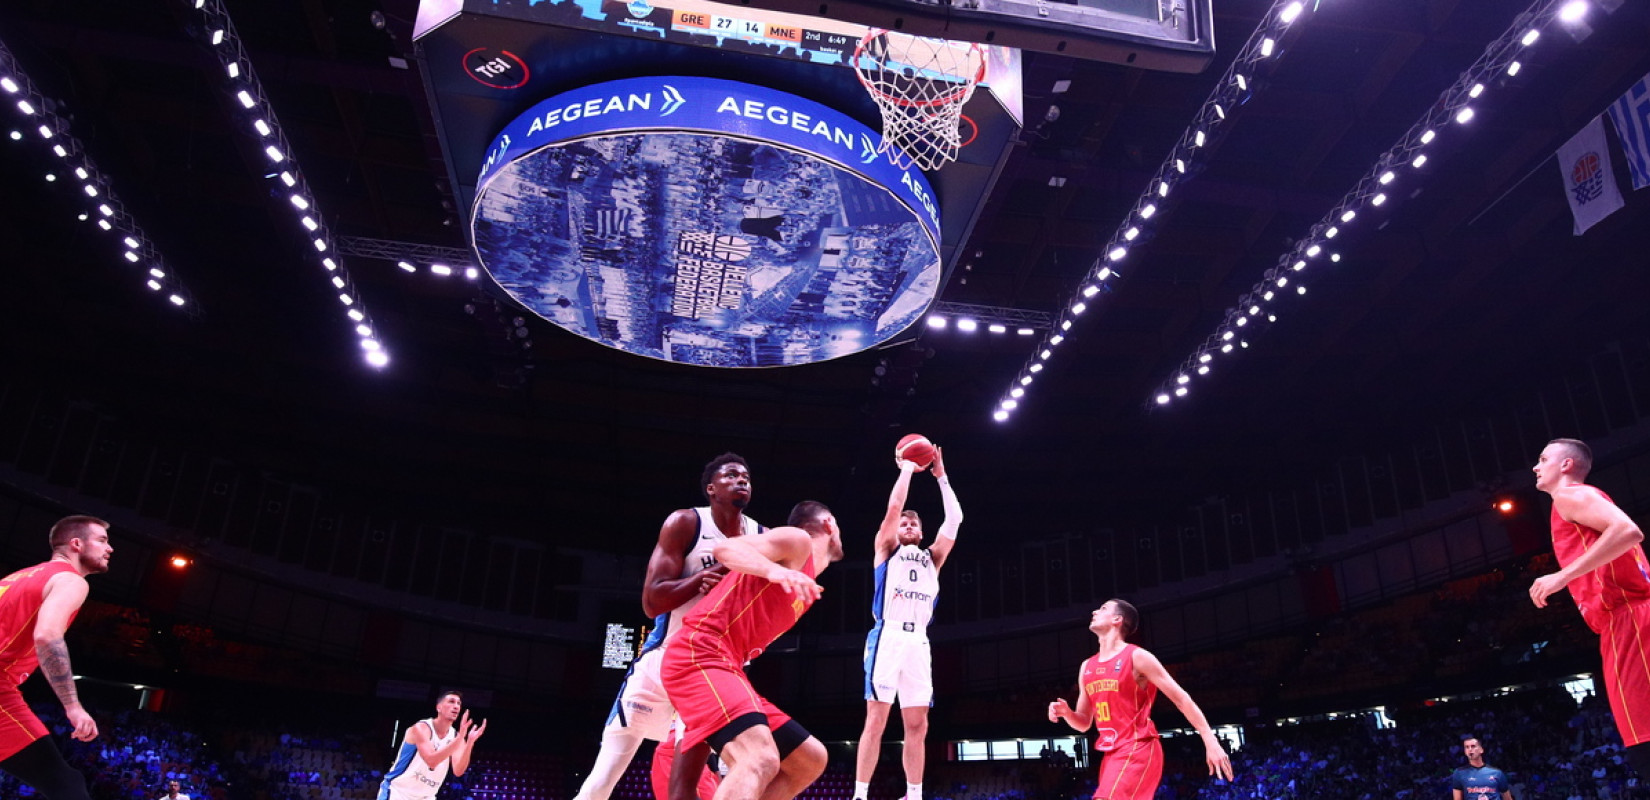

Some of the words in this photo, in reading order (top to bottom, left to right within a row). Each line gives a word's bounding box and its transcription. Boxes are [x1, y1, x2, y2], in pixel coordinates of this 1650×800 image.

[681, 13, 704, 26] GRE
[717, 17, 732, 29] 27
[745, 21, 759, 33] 14
[769, 26, 796, 39] MNE
[805, 31, 820, 41] 2nd
[828, 35, 847, 45] 6:49
[475, 57, 511, 78] TGI
[526, 92, 651, 137] AEGEAN
[717, 96, 854, 151] AEGEAN
[672, 256, 701, 317] FEDERATION
[694, 260, 724, 319] BASKETBALL
[718, 264, 748, 310] HELLENIC
[909, 568, 918, 582] 0
[1096, 701, 1111, 722] 30
